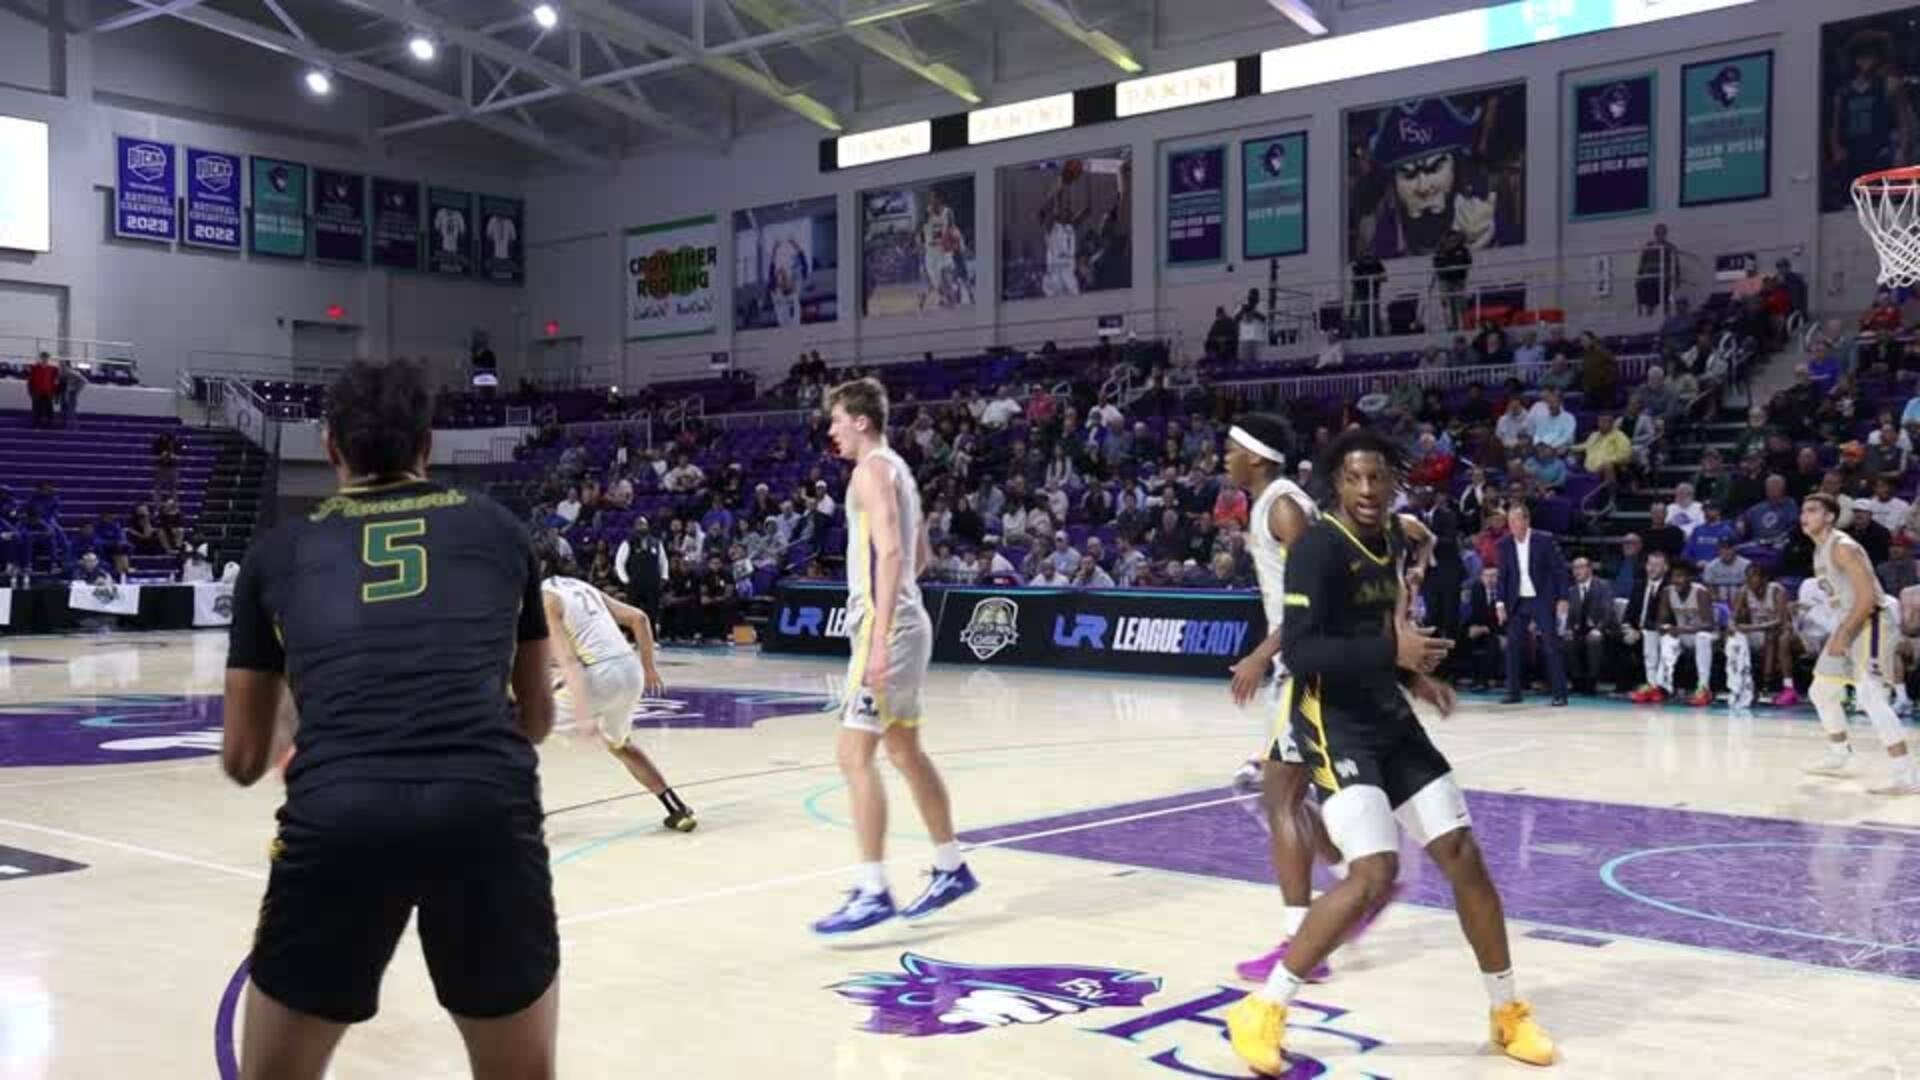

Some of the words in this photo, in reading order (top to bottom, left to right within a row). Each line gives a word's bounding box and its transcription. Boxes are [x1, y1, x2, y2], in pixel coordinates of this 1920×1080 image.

[126, 214, 169, 233] 2023
[194, 223, 235, 241] 2022
[629, 246, 717, 276] CROWTHER
[637, 271, 709, 299] ROOFING
[363, 518, 428, 603] 5
